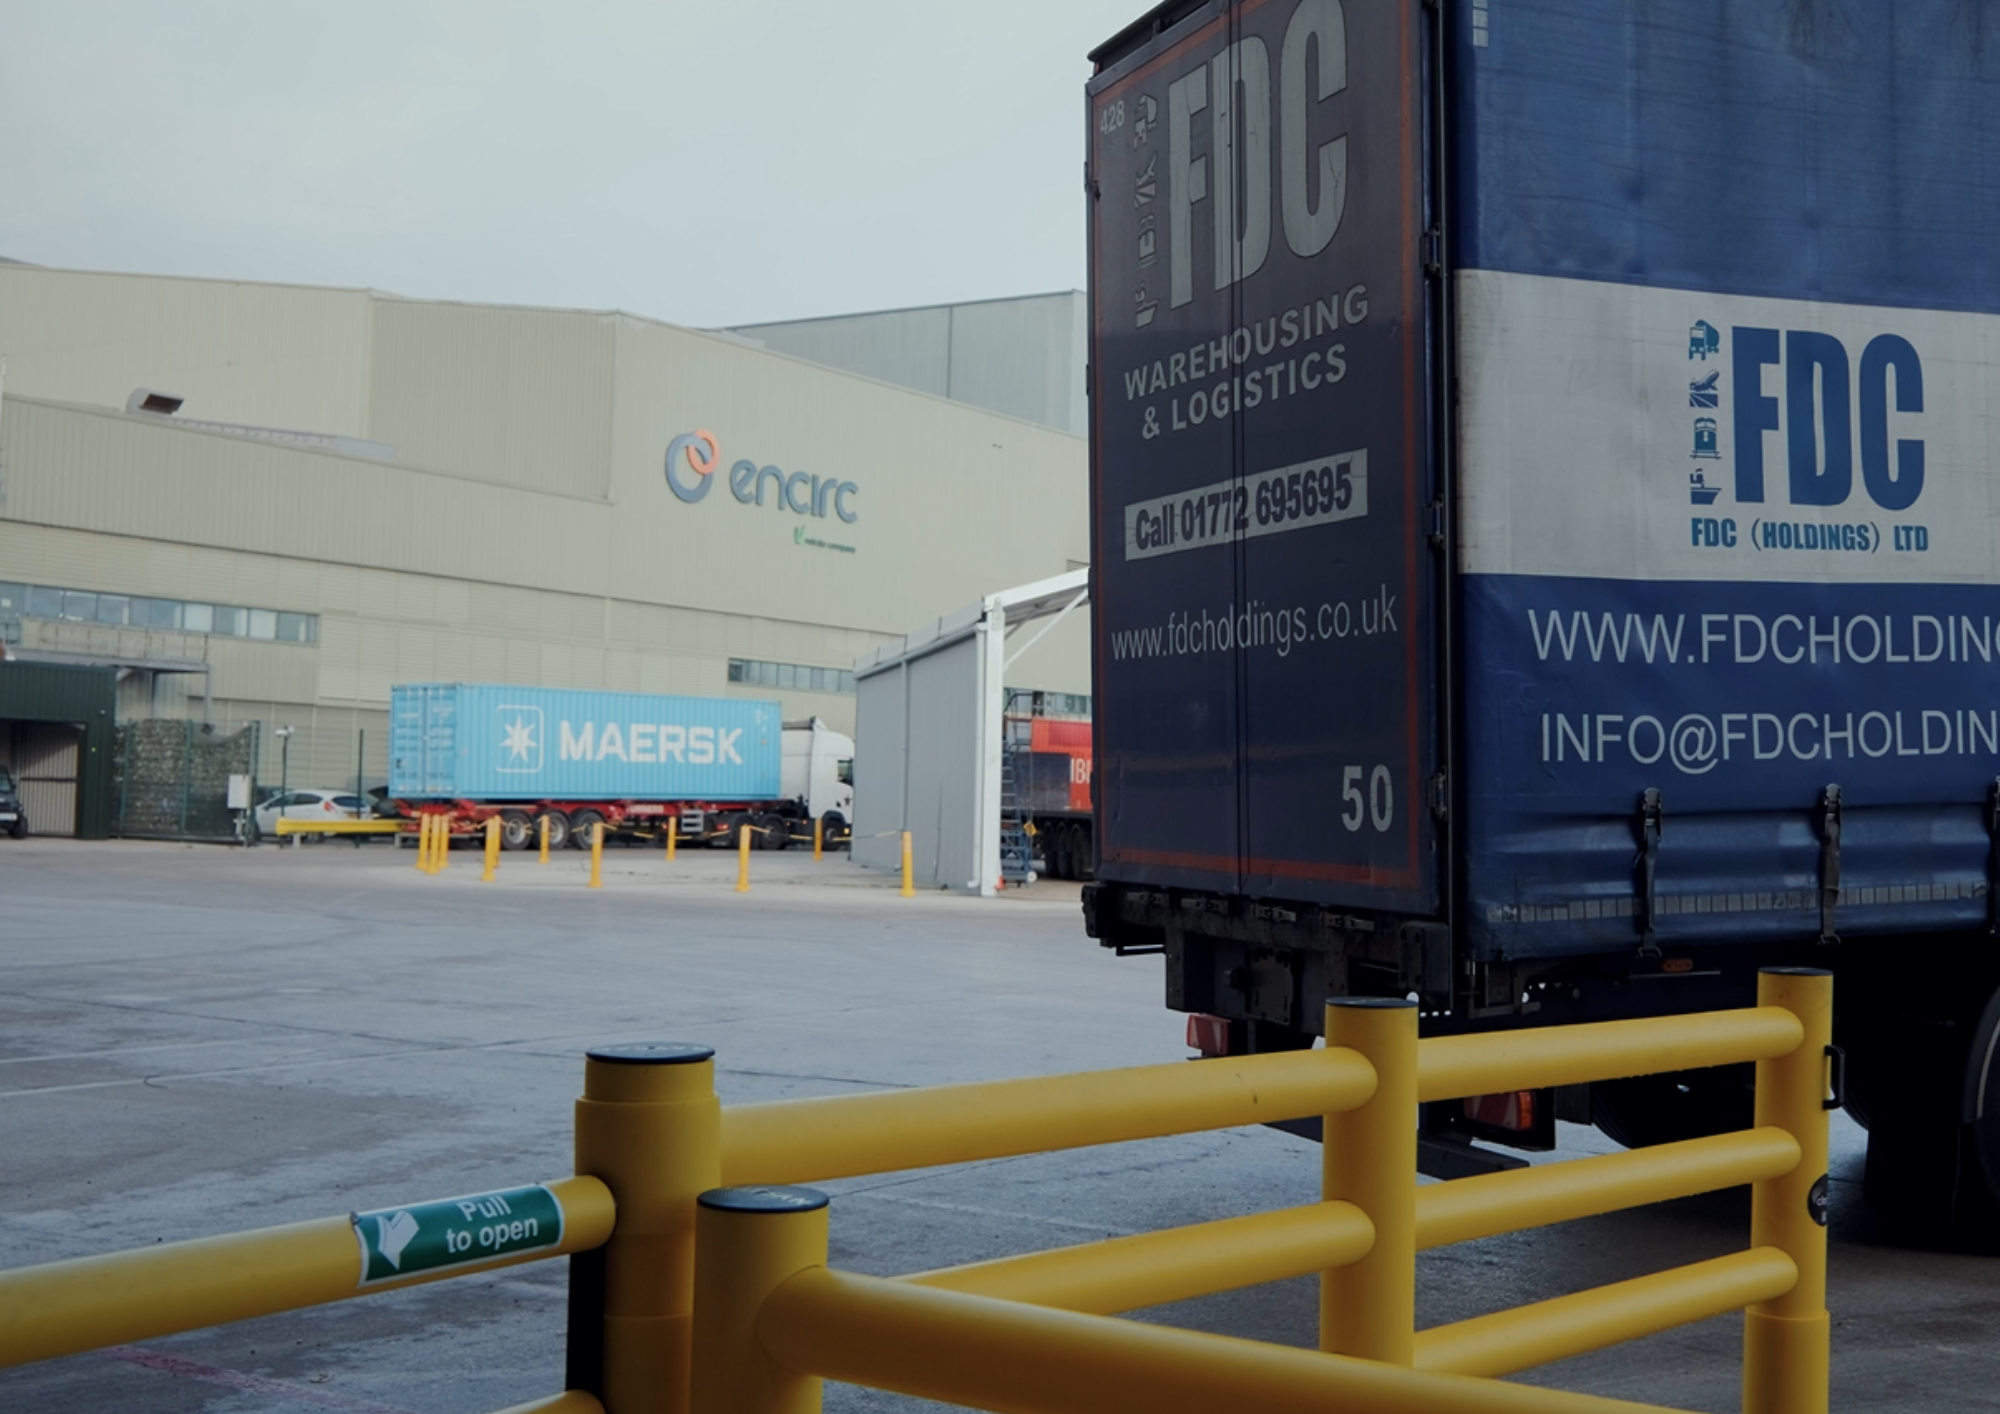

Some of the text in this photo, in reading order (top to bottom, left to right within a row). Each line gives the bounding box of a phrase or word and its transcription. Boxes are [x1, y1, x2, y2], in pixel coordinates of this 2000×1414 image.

[1100, 99, 1126, 135] 428
[1168, 0, 1349, 310] FDC
[1124, 284, 1369, 401] WAREHOUSING
[1142, 344, 1347, 440] & LOGISTICS
[1731, 325, 1925, 511] FDC
[729, 459, 859, 524] encirc
[1135, 463, 1352, 550] Call 01772 695695
[1690, 517, 1929, 554] FDC (HOLDINGS) LTD
[1111, 584, 1398, 660] www.fdcholdings.co.uk
[1527, 608, 2000, 664] WWW.FDCHOLDIN
[559, 720, 744, 765] MAERSK
[1541, 710, 1999, 775] INFO@FDCHOLDIN
[1341, 764, 1394, 832] 50
[446, 1217, 538, 1254] to open
[456, 1195, 512, 1222] Pull
